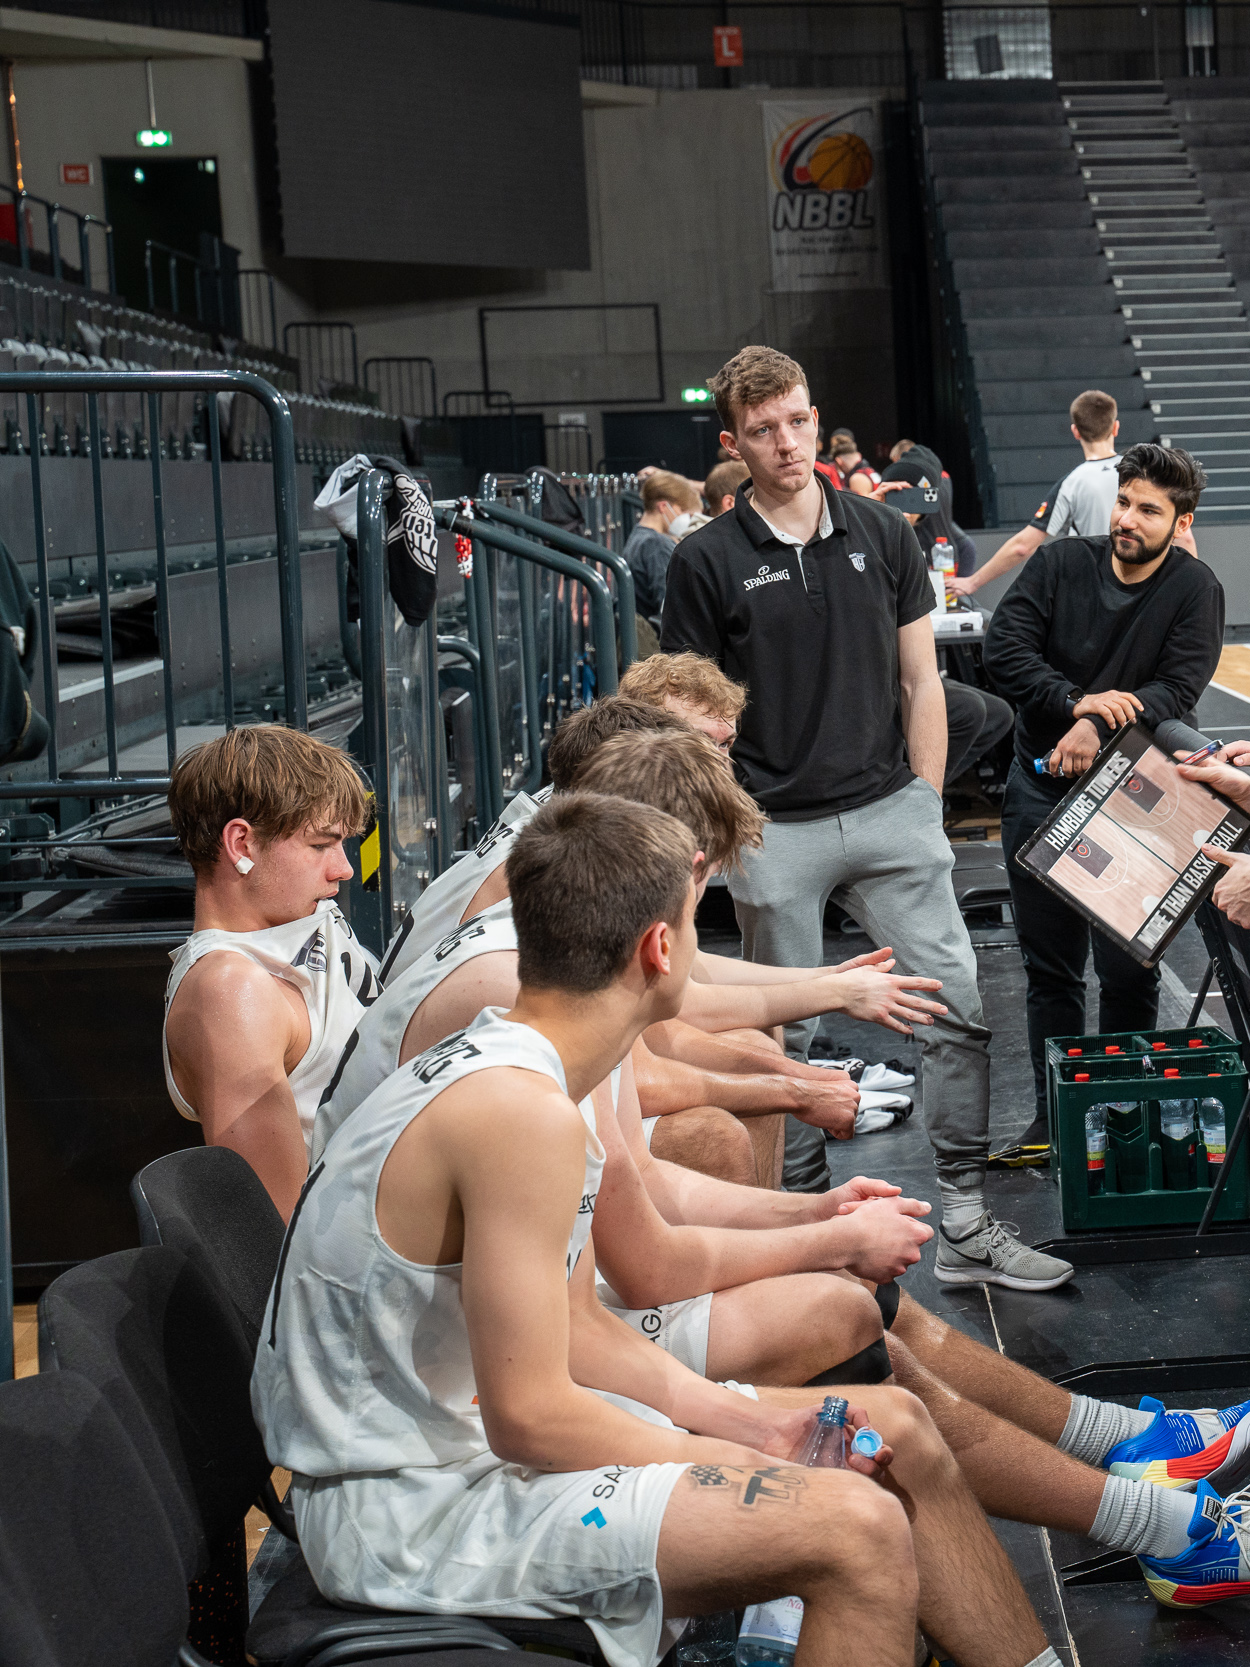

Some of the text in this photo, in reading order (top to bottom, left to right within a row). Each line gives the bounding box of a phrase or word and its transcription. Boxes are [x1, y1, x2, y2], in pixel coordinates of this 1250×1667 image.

[722, 36, 736, 57] L
[774, 192, 876, 231] NBBL
[743, 568, 791, 591] SPALDING
[1044, 792, 1097, 852] HAMBURG
[1160, 881, 1190, 919] THAN
[1183, 820, 1243, 890] BASKBALL
